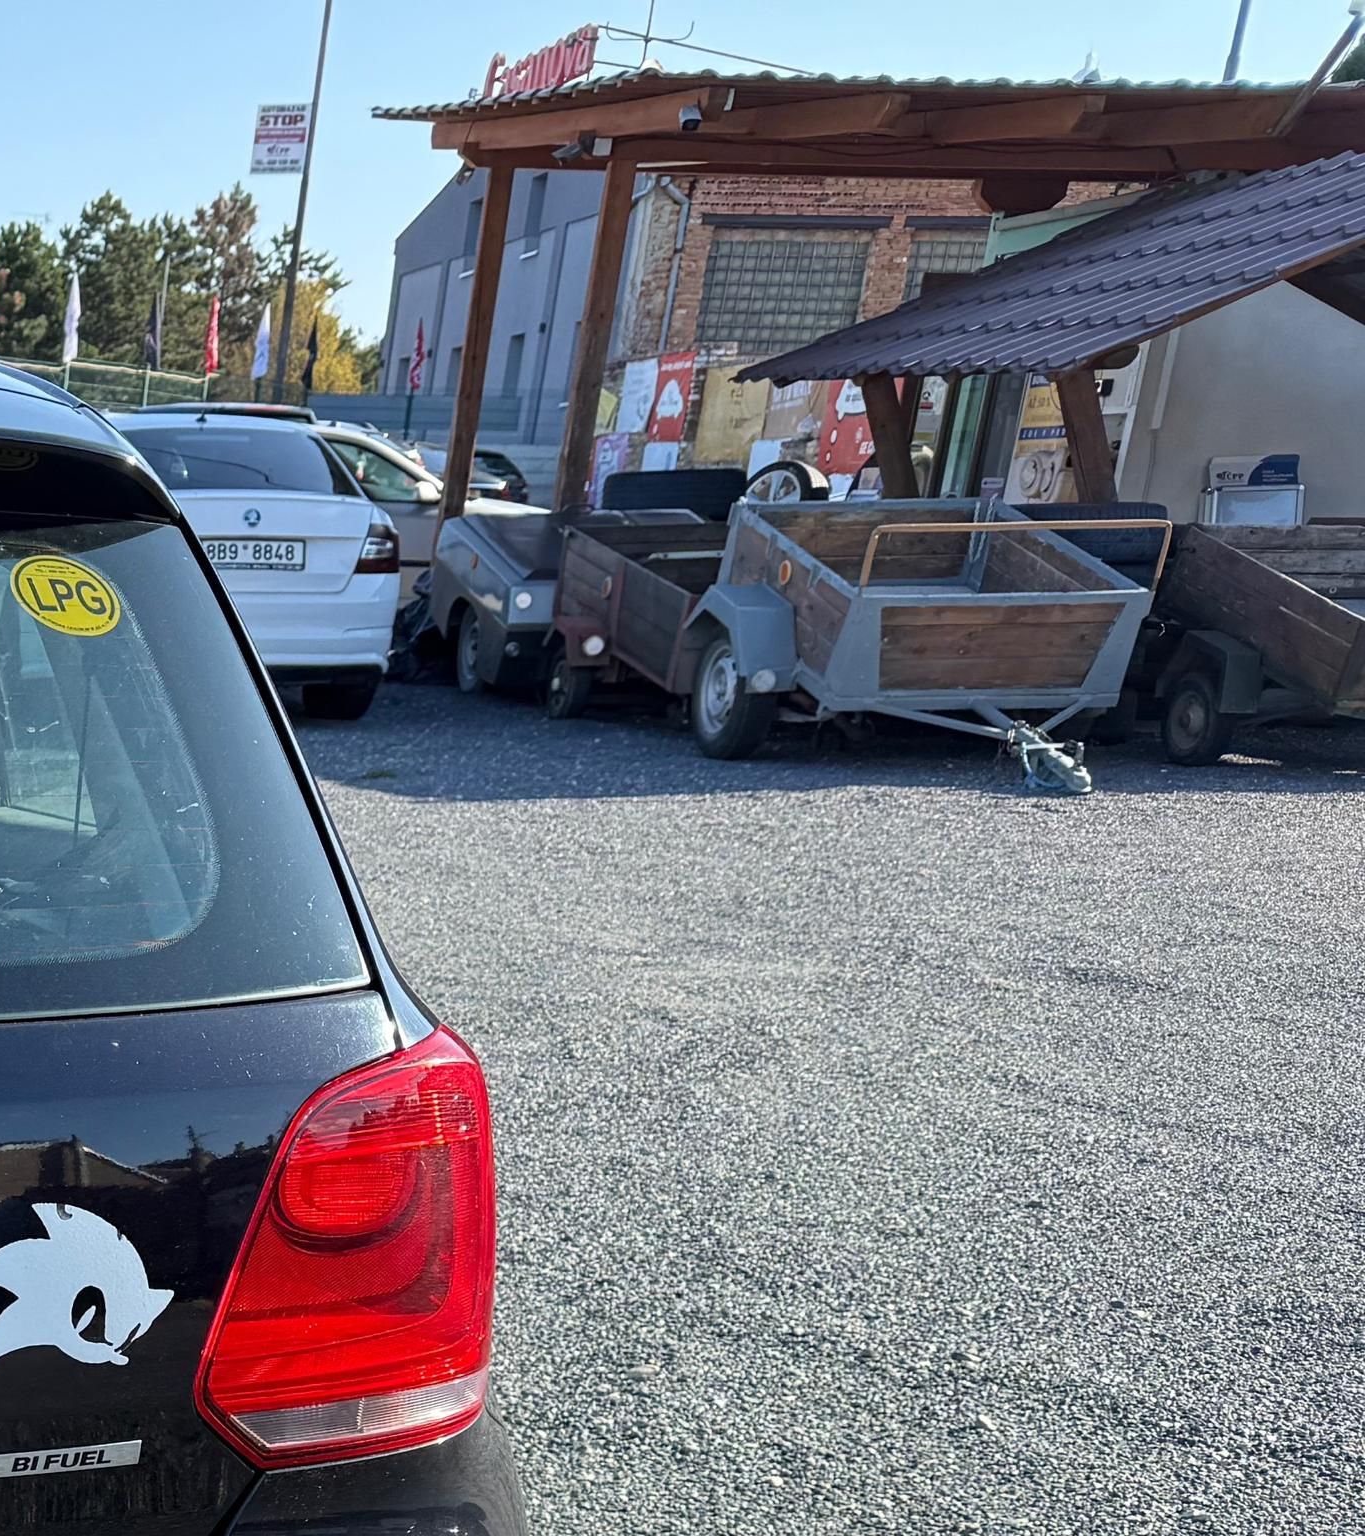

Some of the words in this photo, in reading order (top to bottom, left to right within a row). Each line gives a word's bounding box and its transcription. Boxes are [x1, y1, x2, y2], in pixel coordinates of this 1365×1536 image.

[260, 114, 305, 127] STOP
[207, 543, 238, 561] 8B9
[252, 543, 295, 561] 8848
[26, 577, 107, 616] LPG
[11, 1455, 39, 1473] BI
[43, 1449, 111, 1470] FUEL
